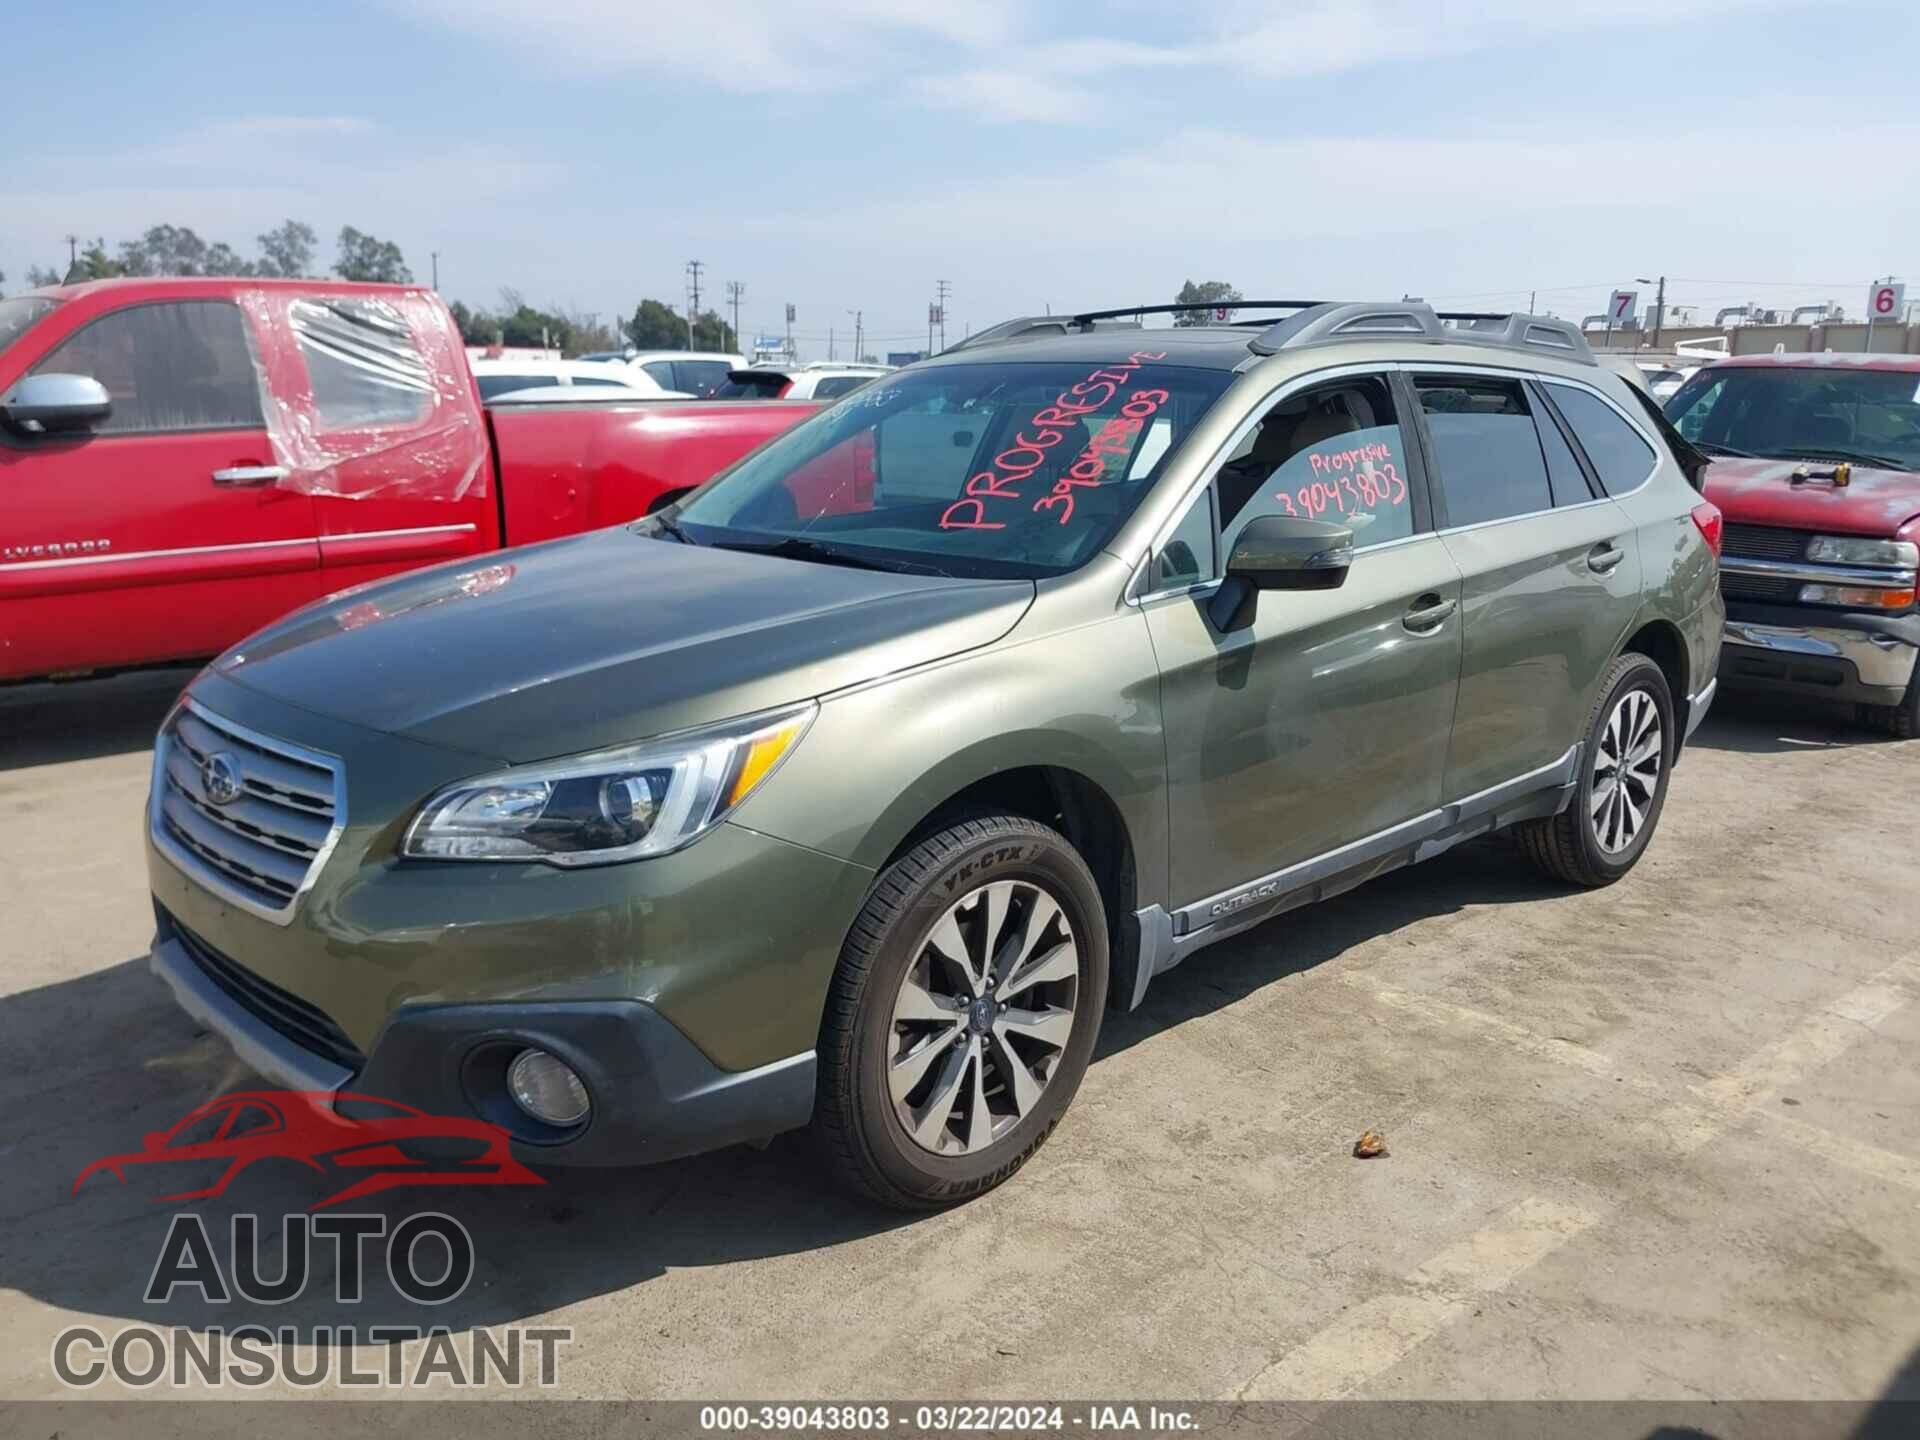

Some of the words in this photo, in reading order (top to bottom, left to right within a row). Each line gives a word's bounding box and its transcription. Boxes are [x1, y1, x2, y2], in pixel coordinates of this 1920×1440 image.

[1616, 295, 1632, 317] 7
[1875, 288, 1895, 313] 6
[1274, 463, 1406, 519] 39043803
[1211, 881, 1279, 915] OUTBACK
